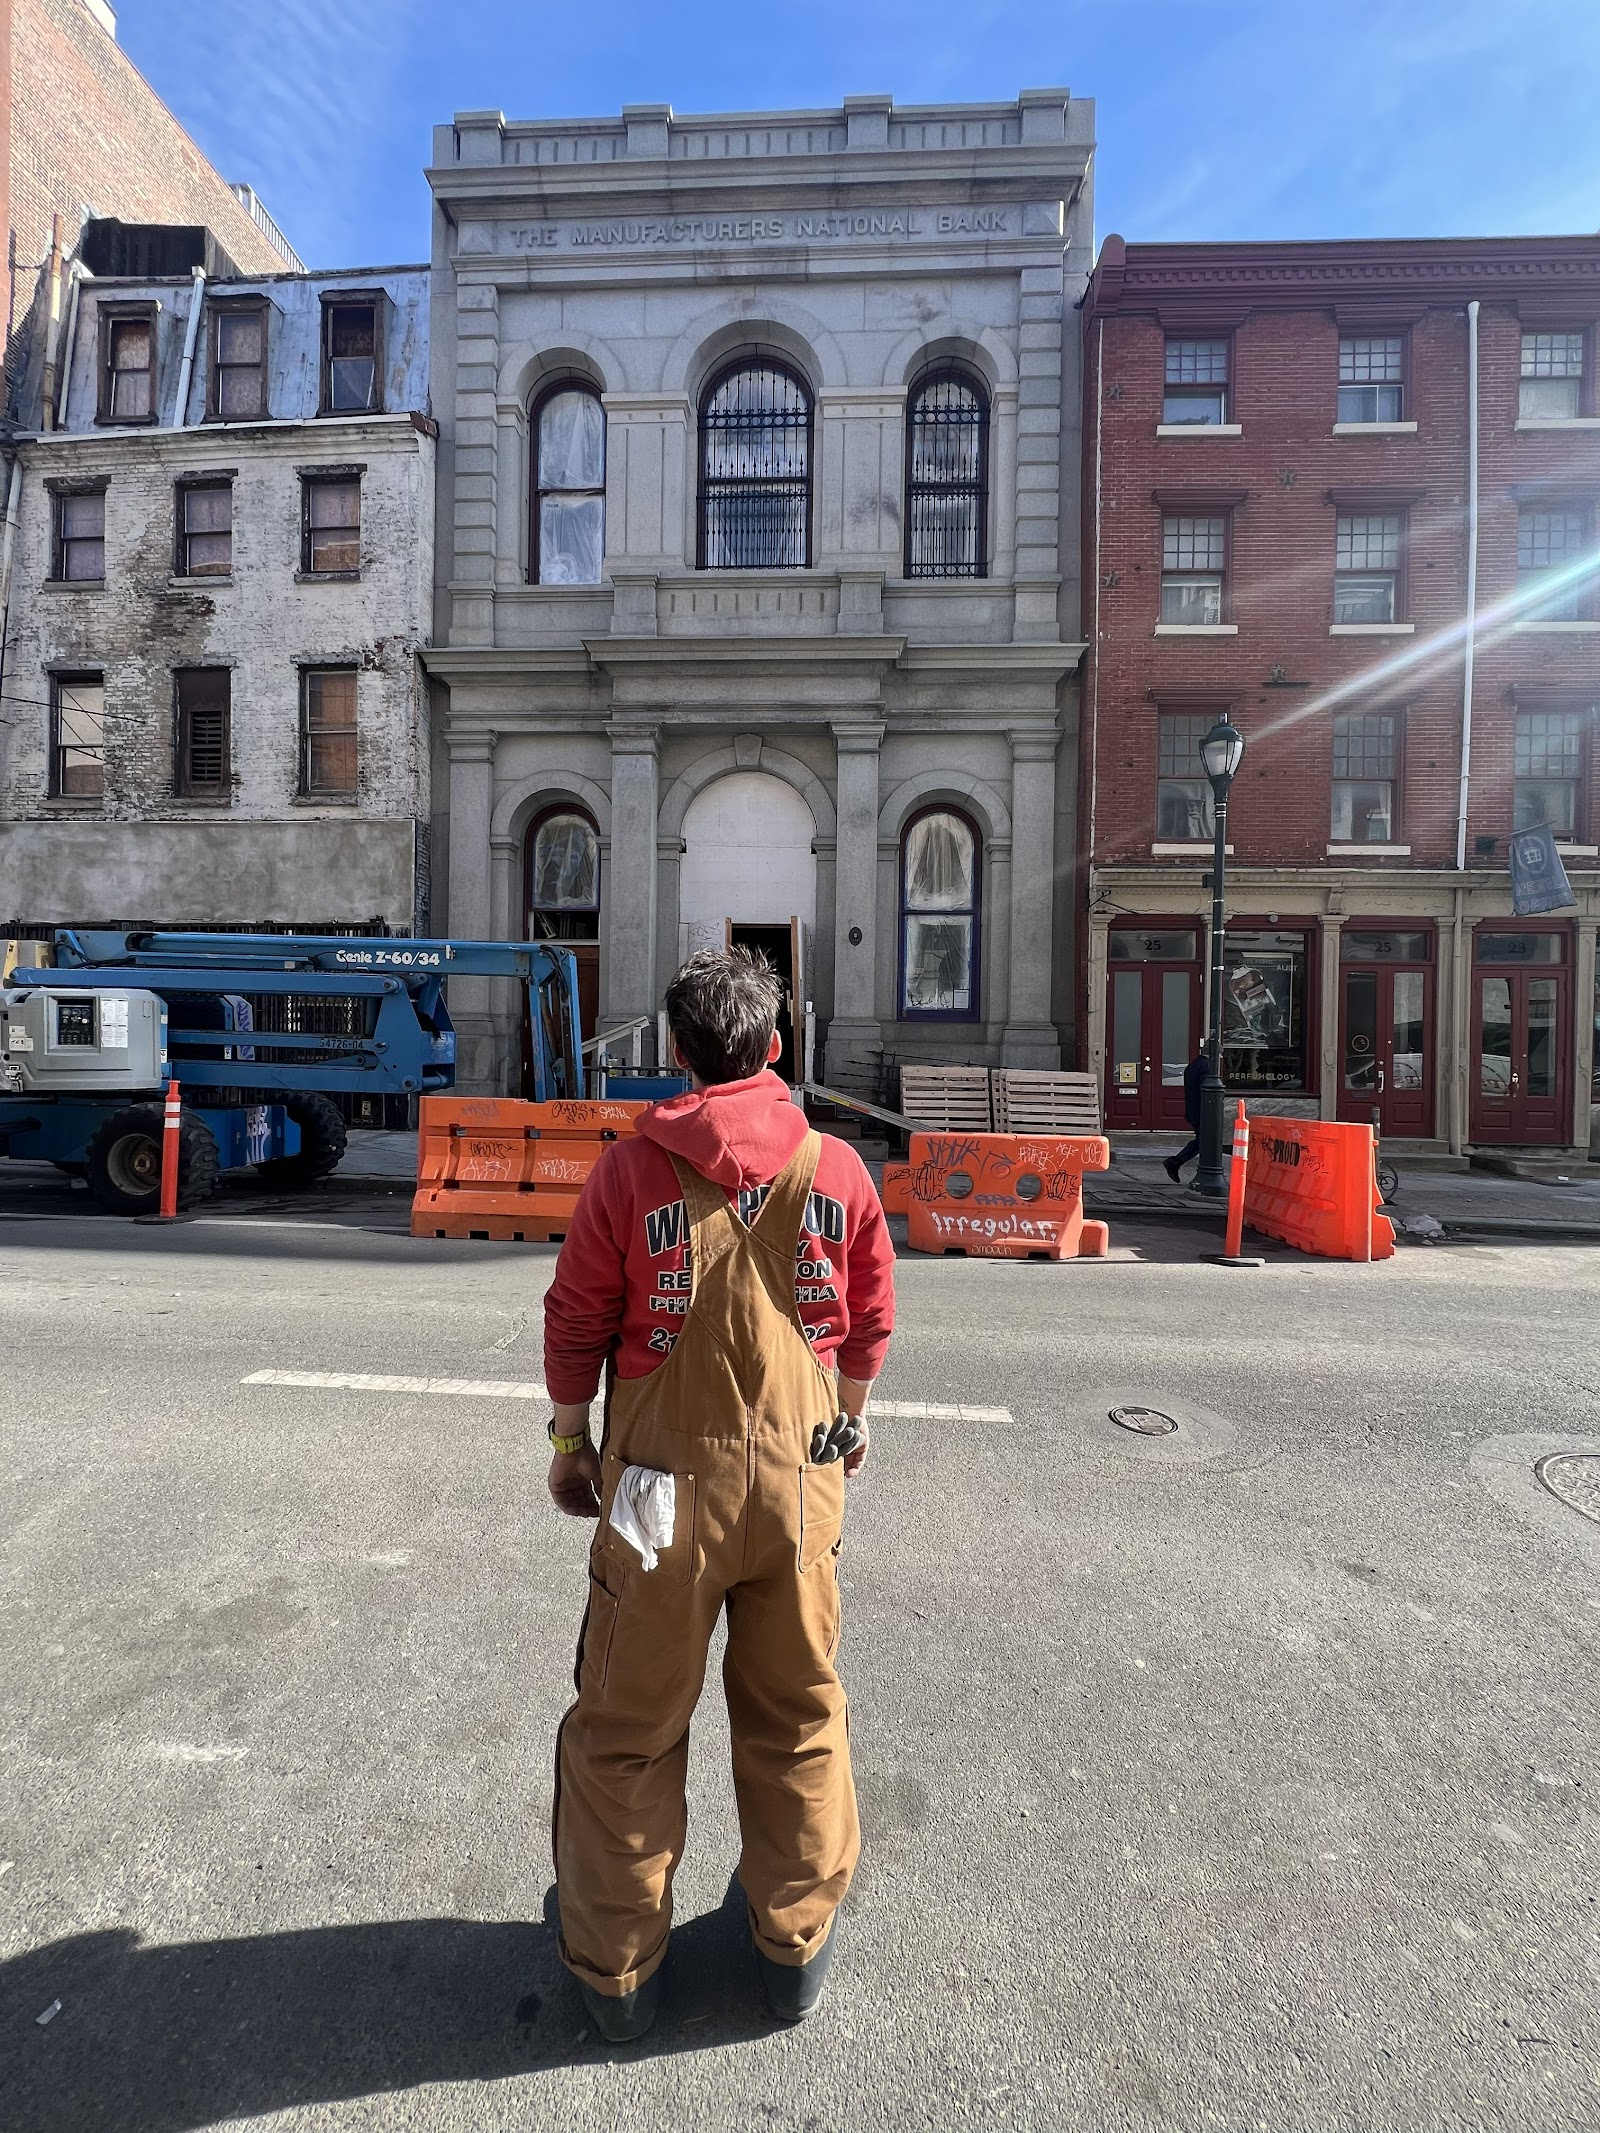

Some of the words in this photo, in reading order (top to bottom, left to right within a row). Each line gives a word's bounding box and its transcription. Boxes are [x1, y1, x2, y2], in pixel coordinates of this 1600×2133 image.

[511, 227, 558, 248] THE
[572, 217, 783, 247] MANUFACTURERS
[797, 212, 922, 238] NATIONAL
[937, 208, 1008, 233] BANK
[1144, 939, 1162, 951] 25
[1374, 941, 1392, 953] 25
[335, 949, 373, 964] Genie
[375, 951, 440, 966] Z-60/34
[1229, 1072, 1296, 1082] PERFUMOLOGY
